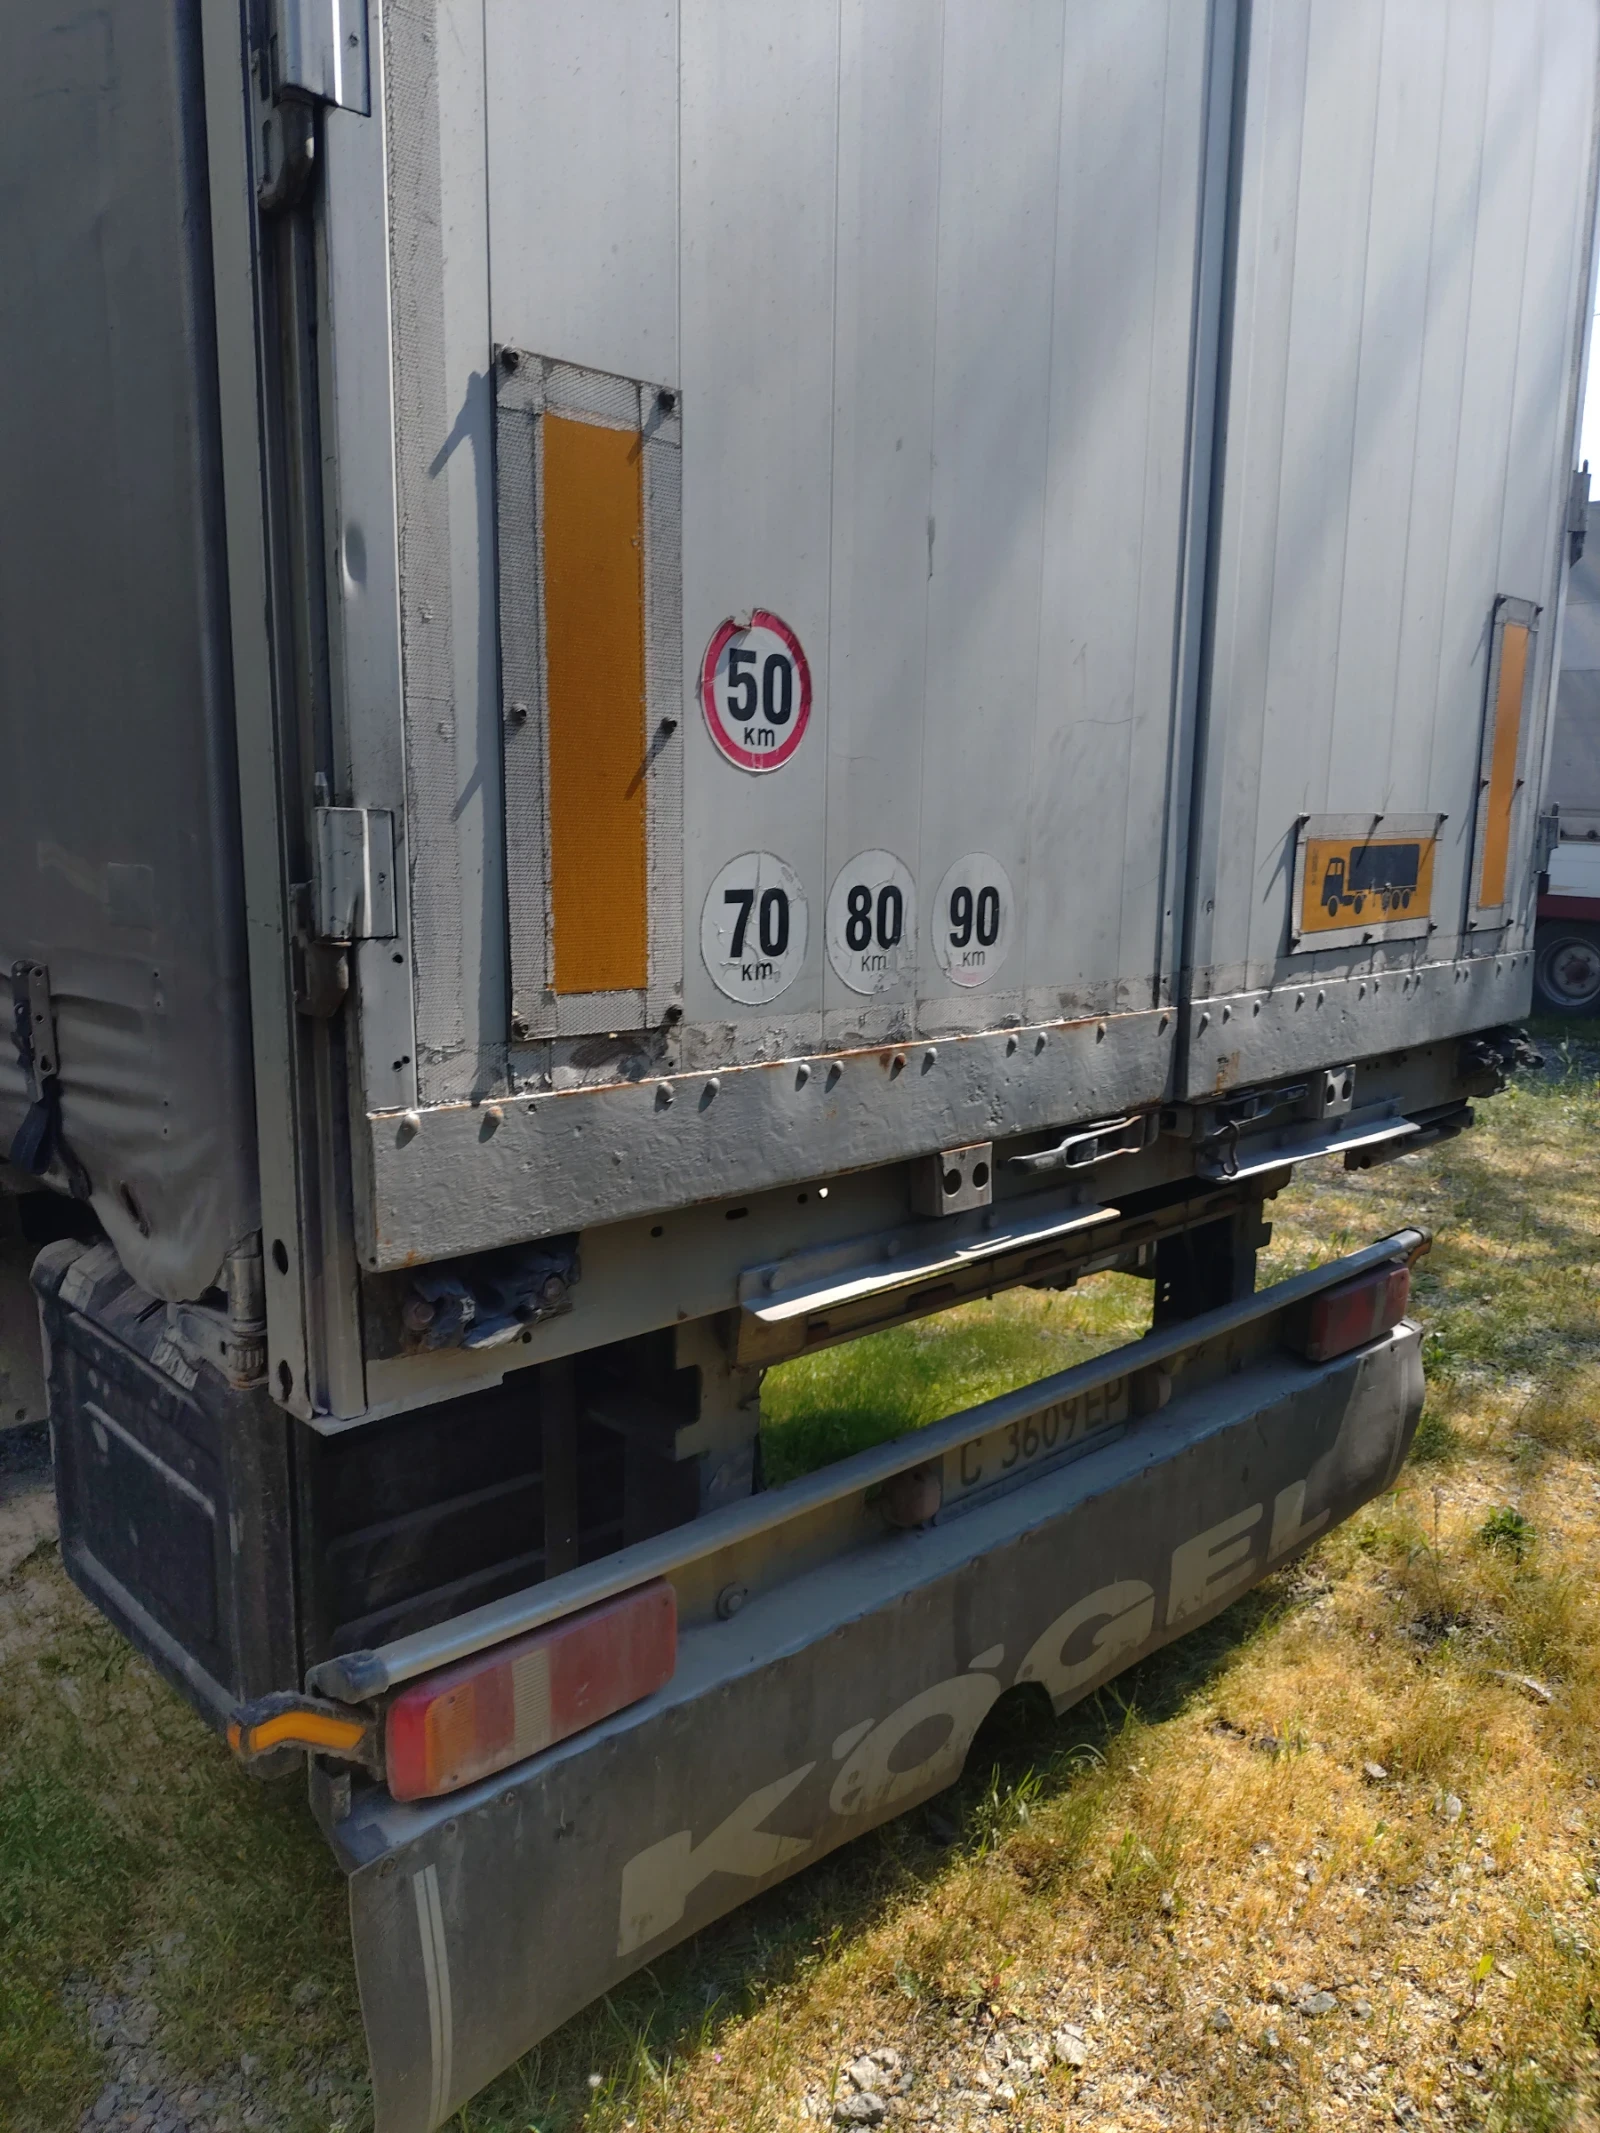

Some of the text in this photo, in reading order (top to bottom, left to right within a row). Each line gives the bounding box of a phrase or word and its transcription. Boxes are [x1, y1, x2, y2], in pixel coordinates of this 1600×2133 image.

[727, 648, 793, 726] 50
[723, 887, 790, 958] 70
[845, 884, 904, 952] 80
[948, 885, 1000, 948] 90
[959, 1376, 1124, 1486] C 3609 EP
